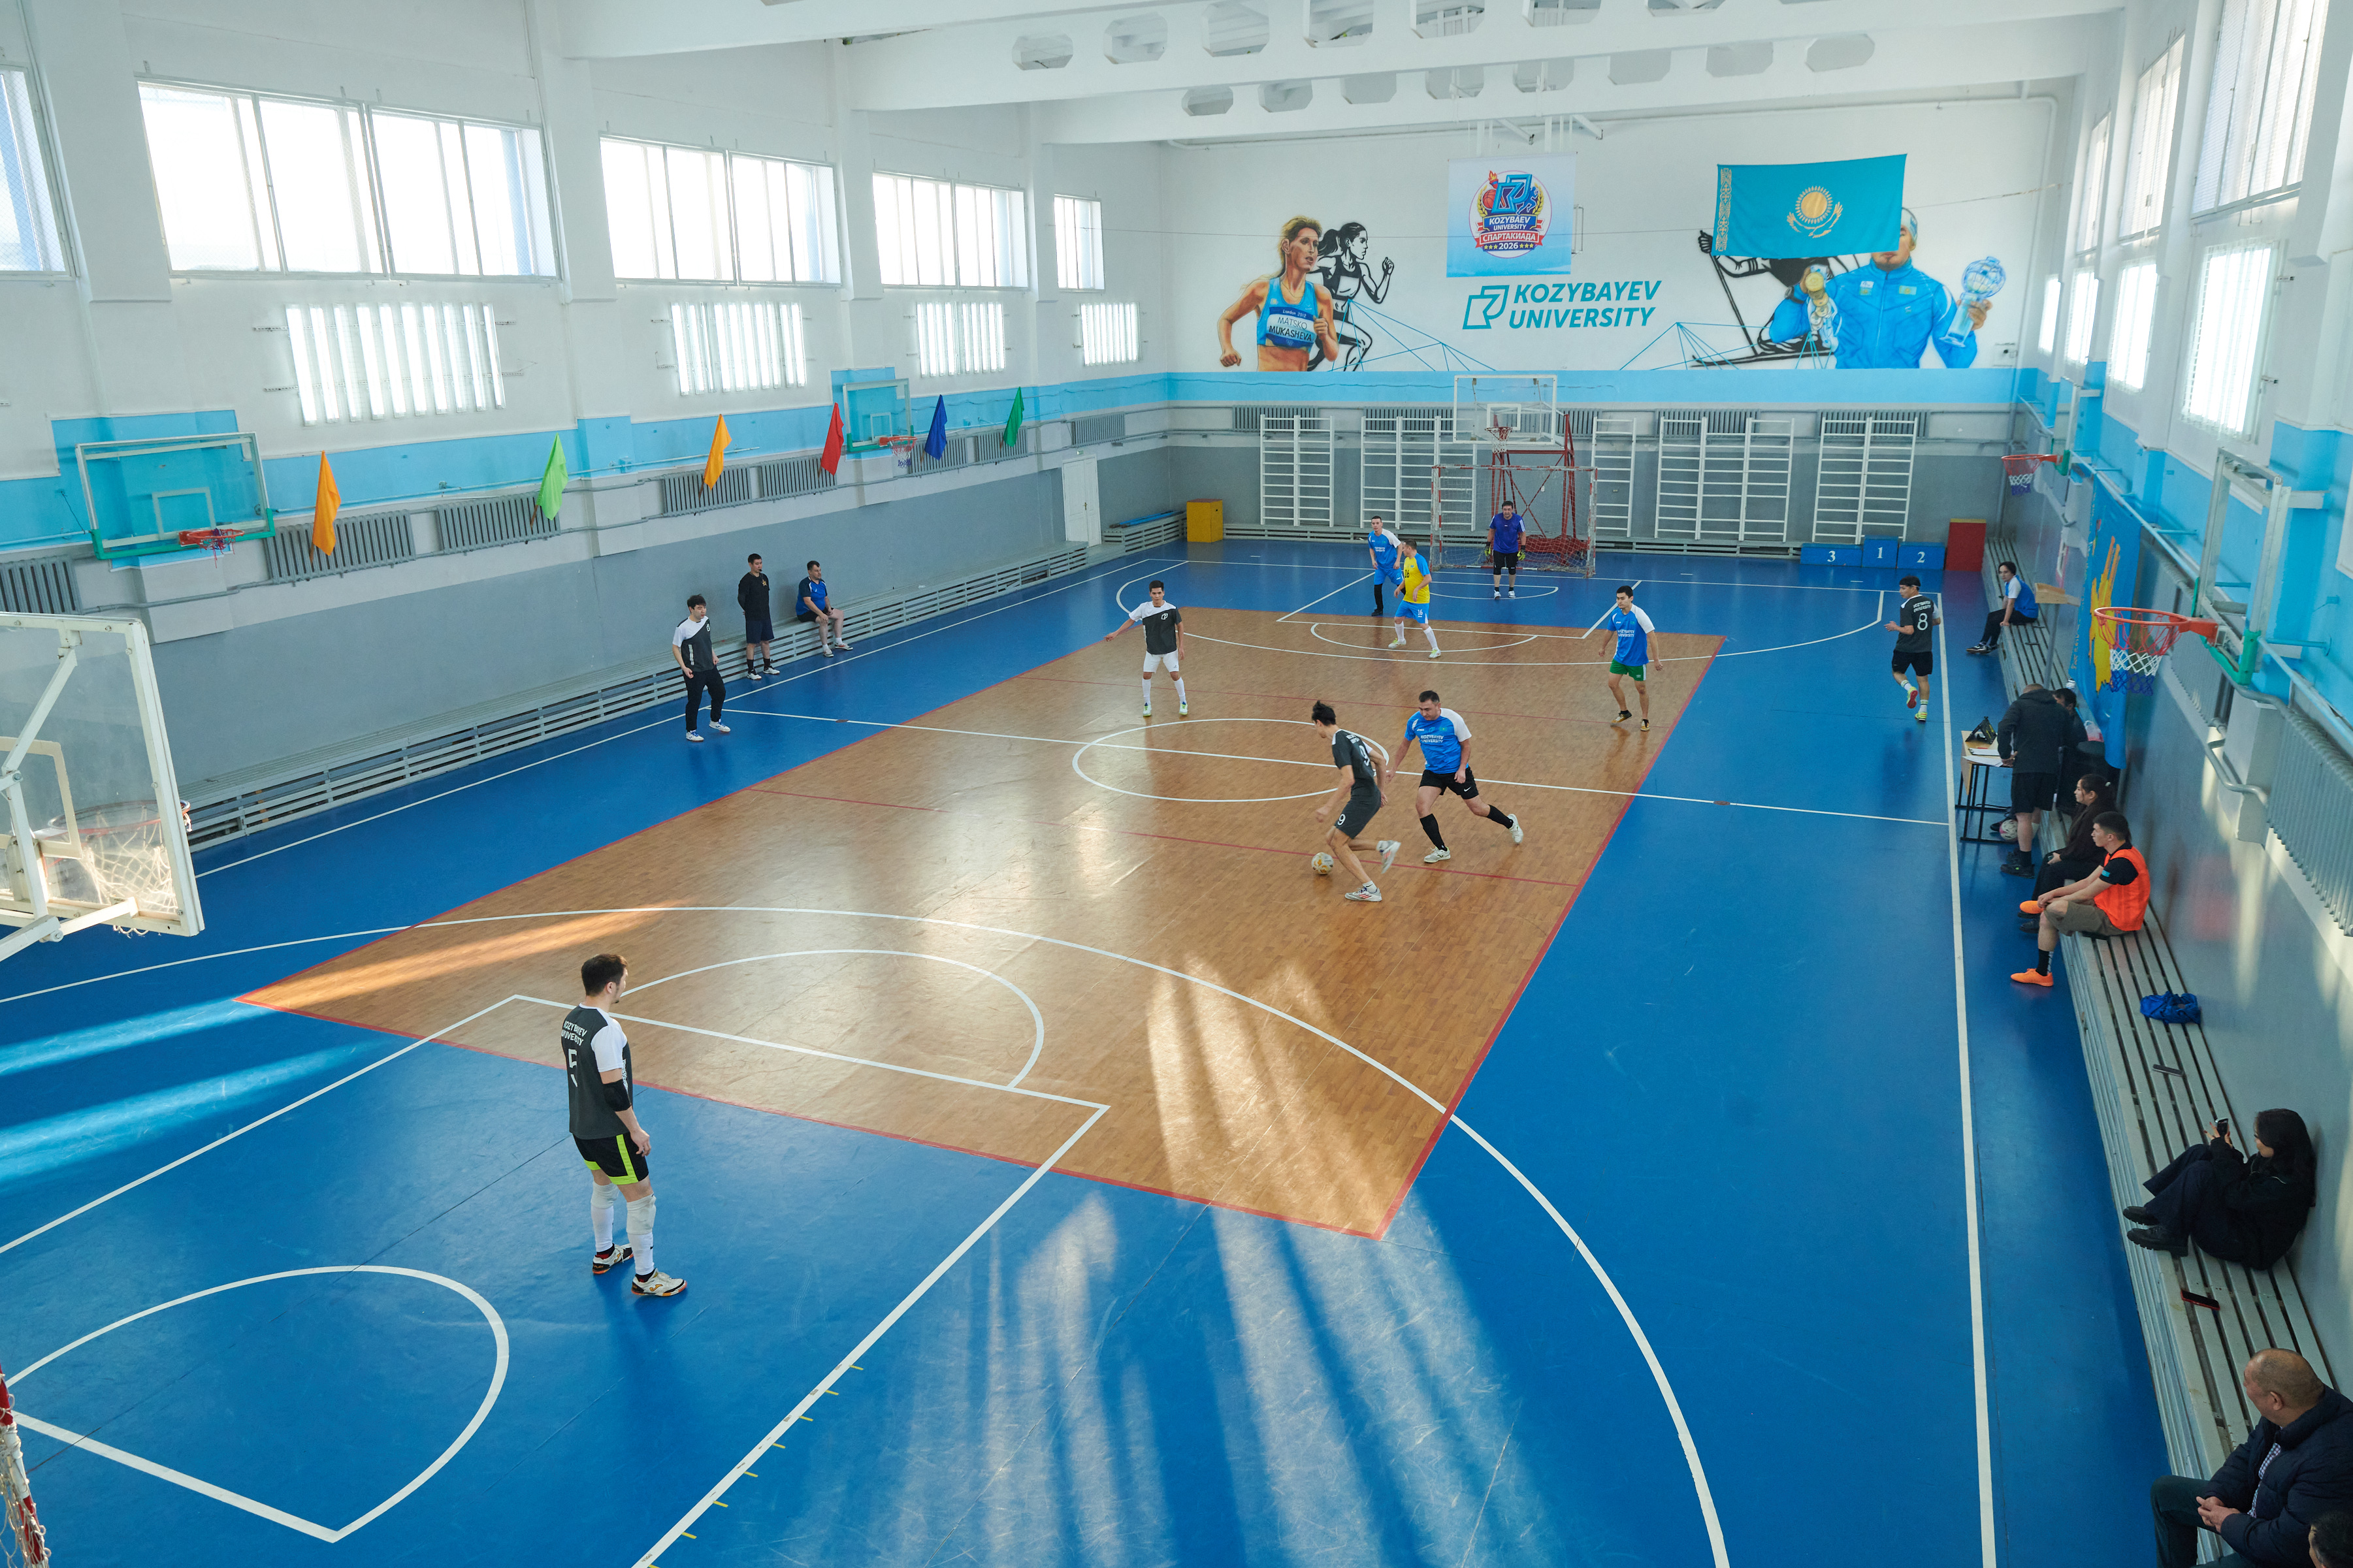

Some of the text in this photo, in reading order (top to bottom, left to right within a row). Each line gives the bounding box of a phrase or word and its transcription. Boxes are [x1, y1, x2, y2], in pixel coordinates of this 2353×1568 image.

[1489, 216, 1531, 225] KOZYBAEV
[1482, 232, 1536, 242] СПАРТАКИАДА
[1514, 280, 1663, 304] KOZYBAYEV
[1277, 317, 1307, 330] MATSKO
[1509, 307, 1656, 329] UNIVERSITY
[1269, 325, 1312, 342] MUKASHEVA
[1827, 551, 1836, 562] 3
[1877, 547, 1883, 559] 1
[1917, 551, 1926, 563] 2
[1404, 569, 1410, 578] 16
[1917, 613, 1928, 631] 8
[1359, 745, 1370, 766] 9
[1337, 814, 1346, 825] 9
